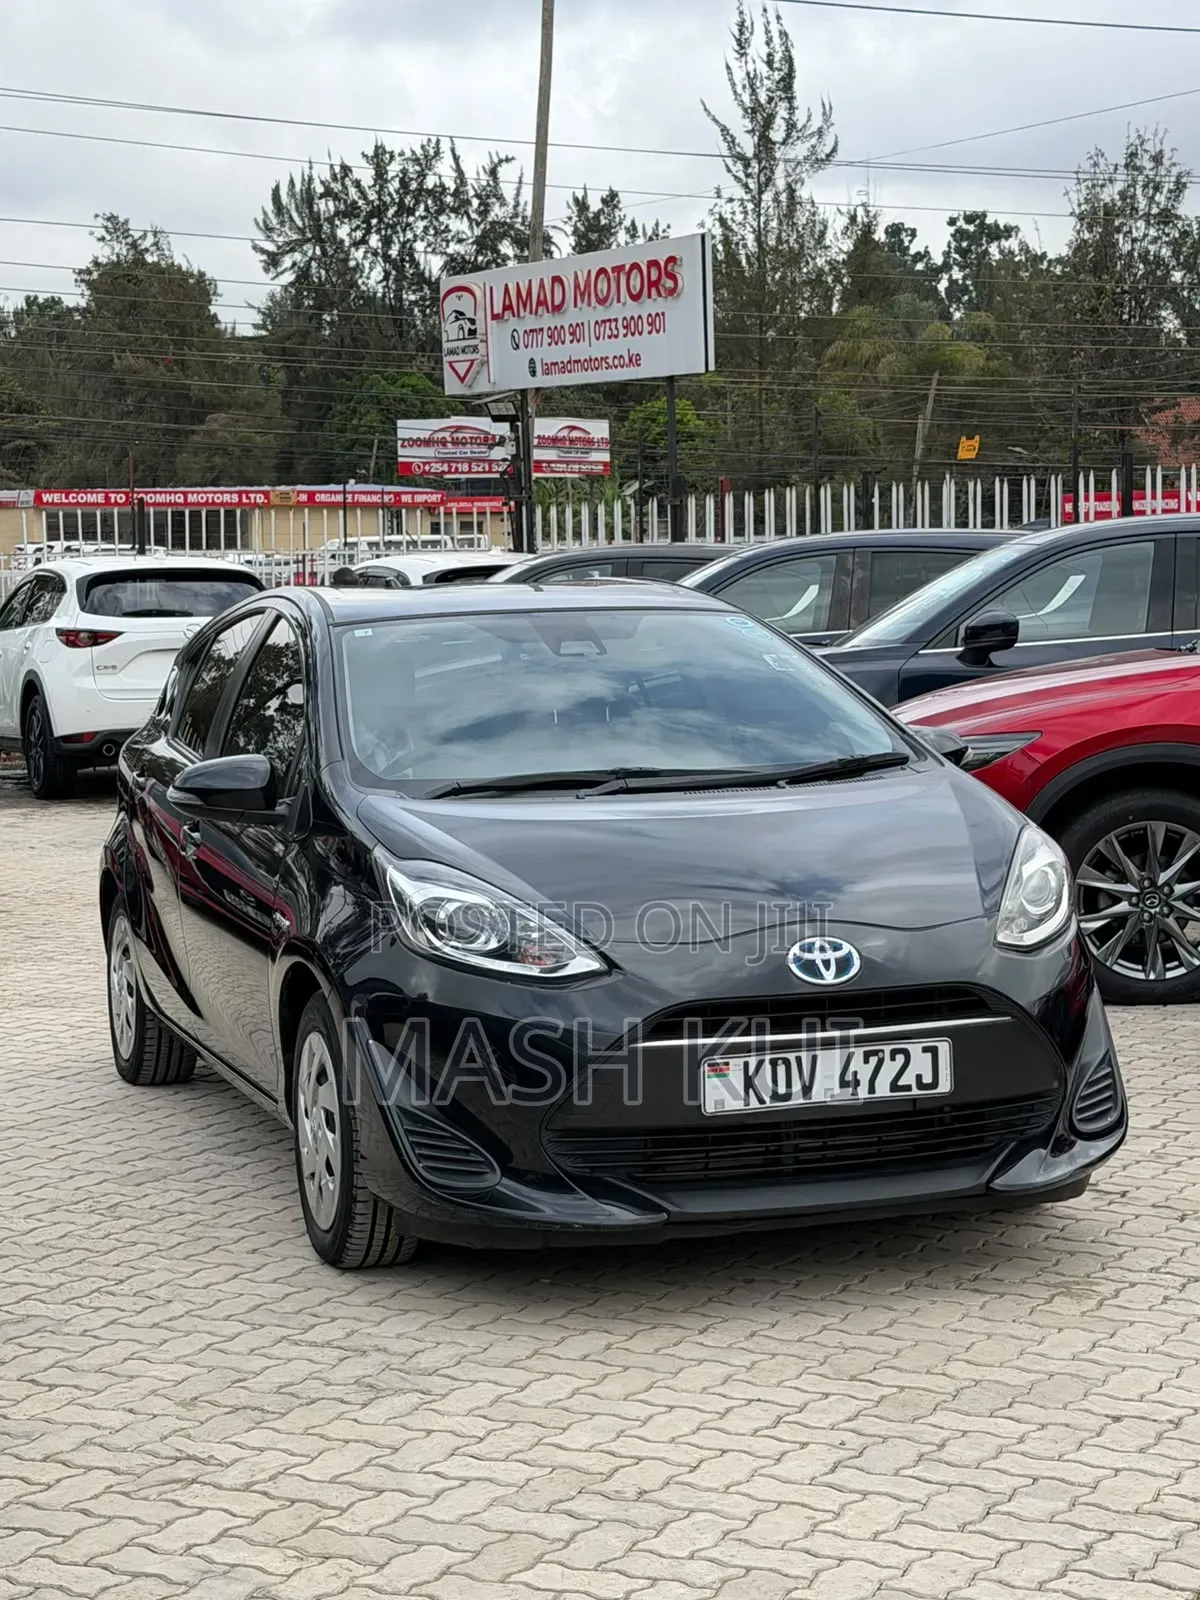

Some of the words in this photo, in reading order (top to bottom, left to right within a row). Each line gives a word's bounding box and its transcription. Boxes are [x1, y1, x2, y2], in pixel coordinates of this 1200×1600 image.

[489, 275, 568, 321] LAMAD
[573, 255, 682, 309] MOTORS
[547, 324, 566, 347] 900
[568, 322, 585, 344] 901
[594, 317, 619, 341] 0733
[622, 314, 644, 338] 900
[646, 311, 666, 335] 901
[444, 345, 460, 357] LAMAD
[461, 343, 480, 355] MOTORS
[541, 348, 642, 376] lamadmotors.co.ke
[424, 462, 448, 473] +254
[450, 462, 469, 473] 718
[471, 462, 489, 472] 521
[41, 493, 106, 503] WELCOME
[108, 493, 126, 503] TO
[188, 493, 239, 503] MOTORS
[242, 493, 268, 503] LTD.
[401, 493, 412, 503] WE
[414, 493, 442, 503] IMPORT
[743, 1053, 819, 1107] KDV
[839, 1045, 940, 1098] 472J
